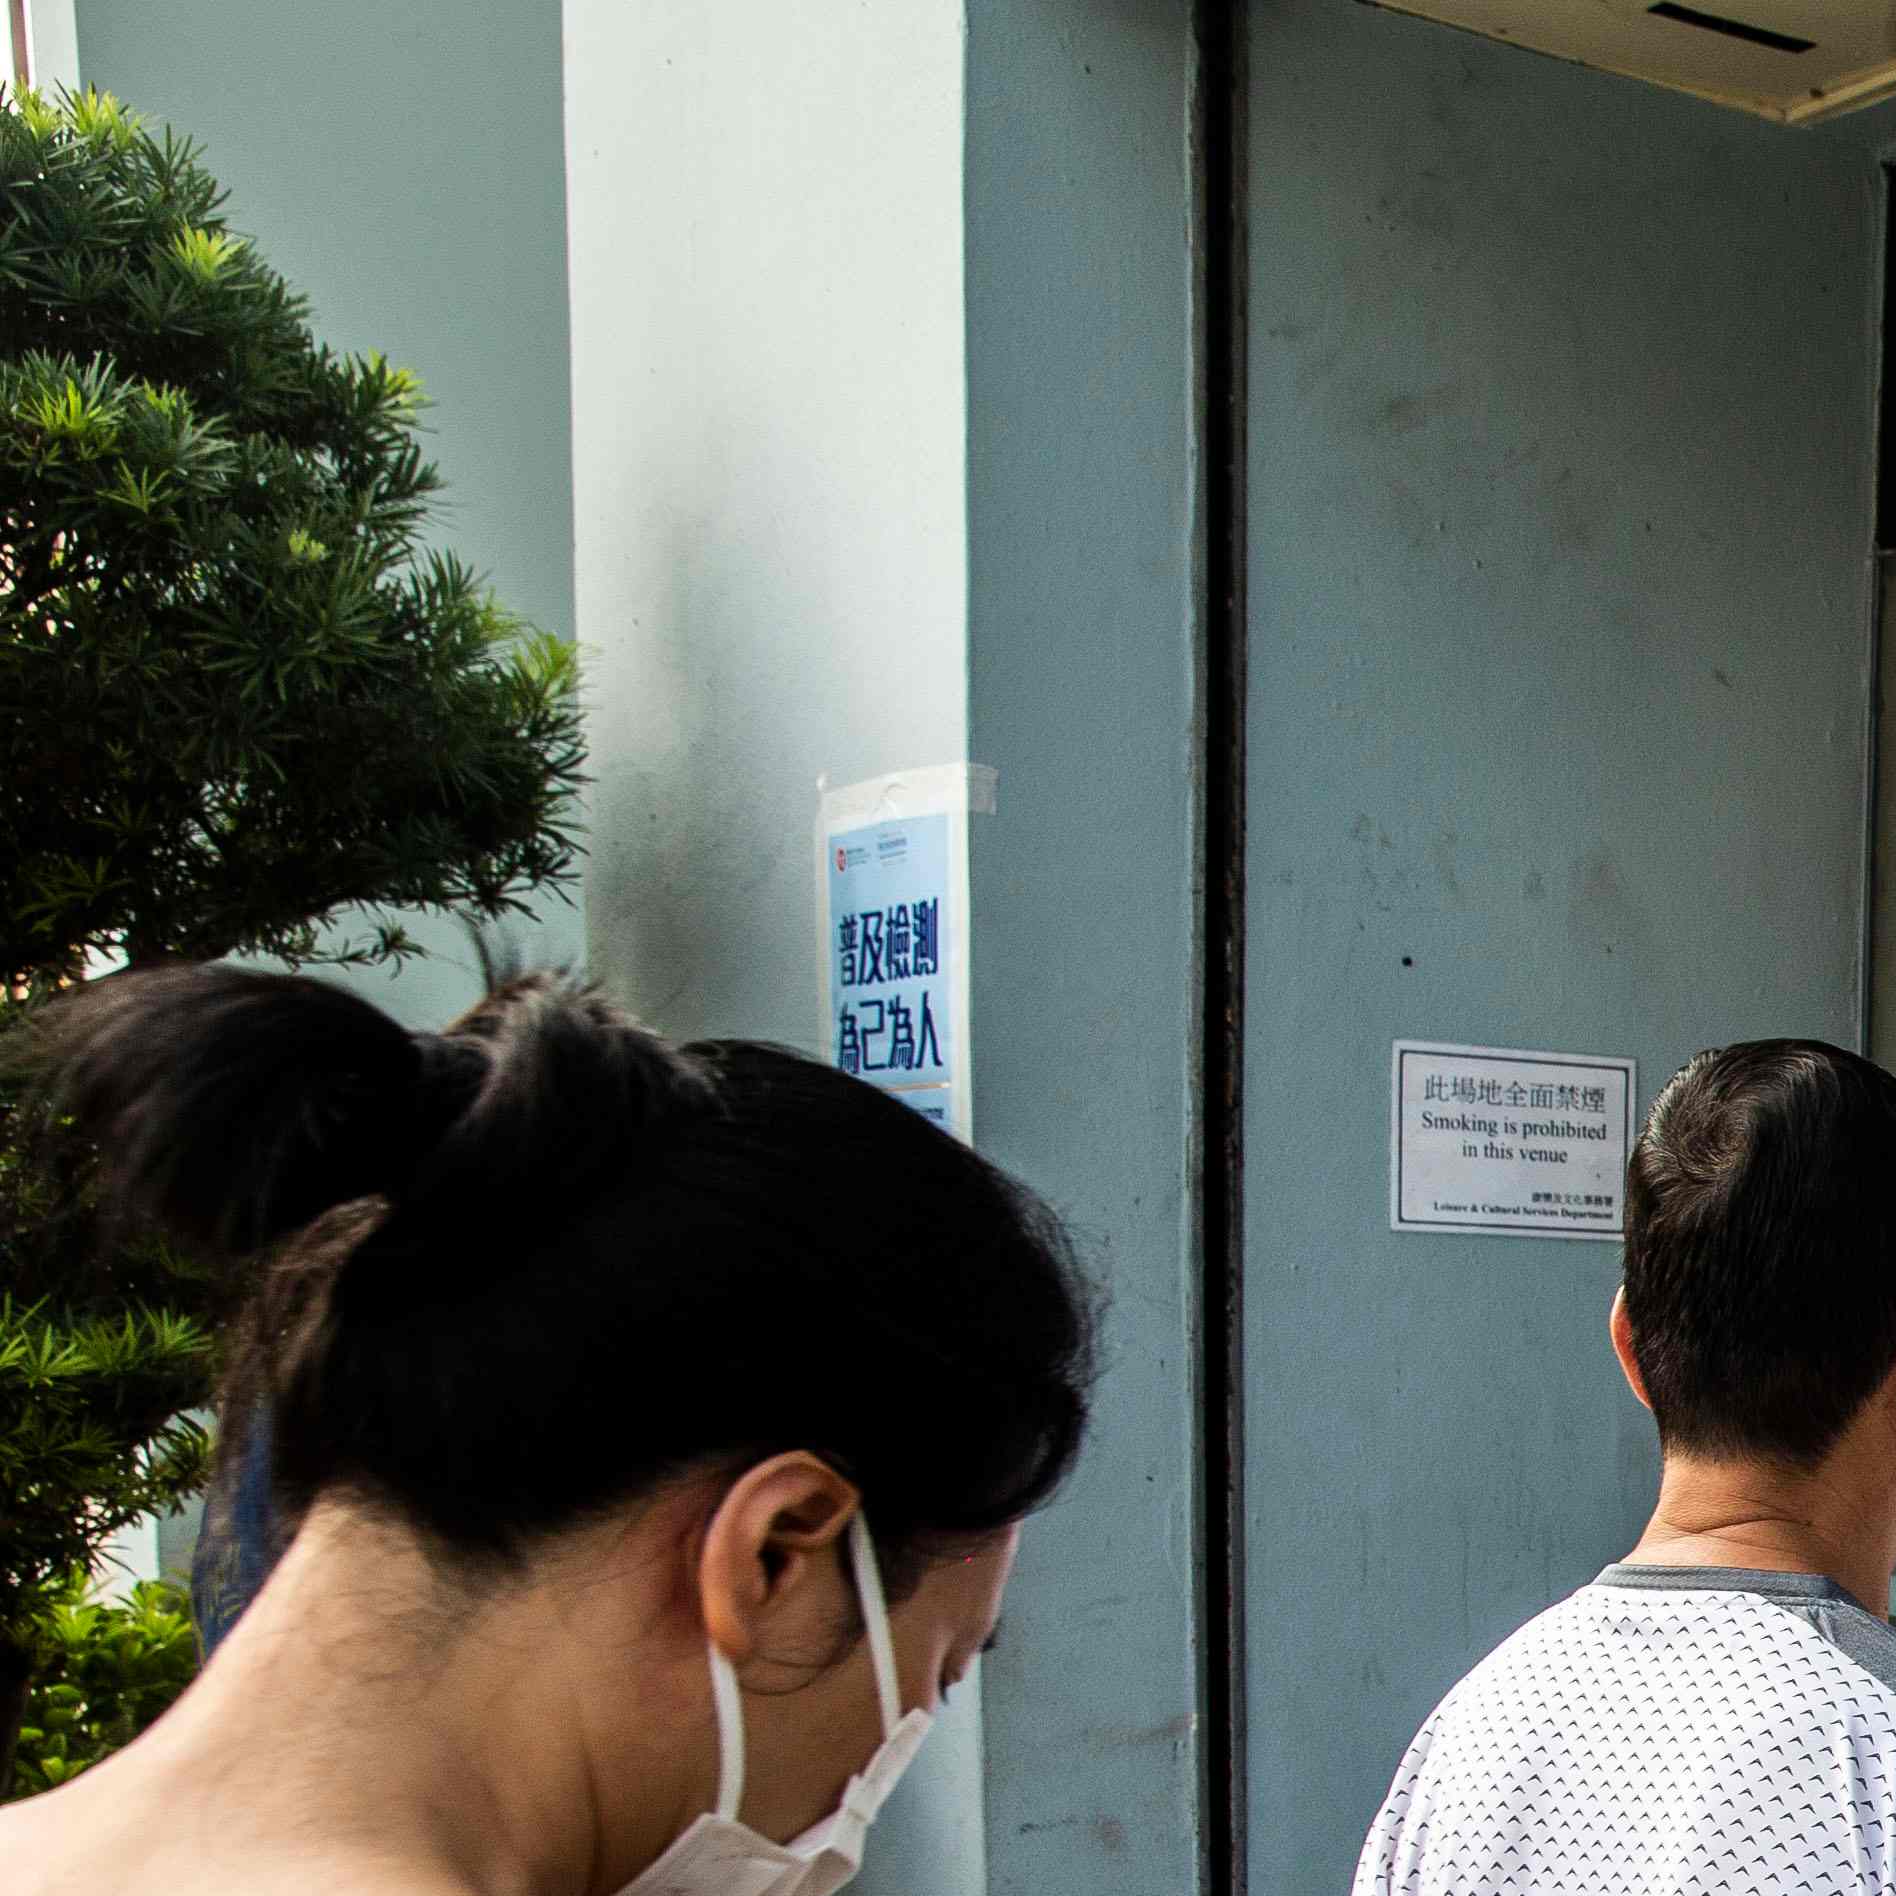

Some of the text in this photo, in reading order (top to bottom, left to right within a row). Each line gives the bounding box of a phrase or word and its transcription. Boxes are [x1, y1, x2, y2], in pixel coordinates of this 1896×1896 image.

[838, 897, 939, 986] 普及檢測
[1421, 1111, 1607, 1140] Smoking is prohibited
[1462, 1141, 1568, 1164] in this venue
[1561, 1208, 1613, 1220] Department
